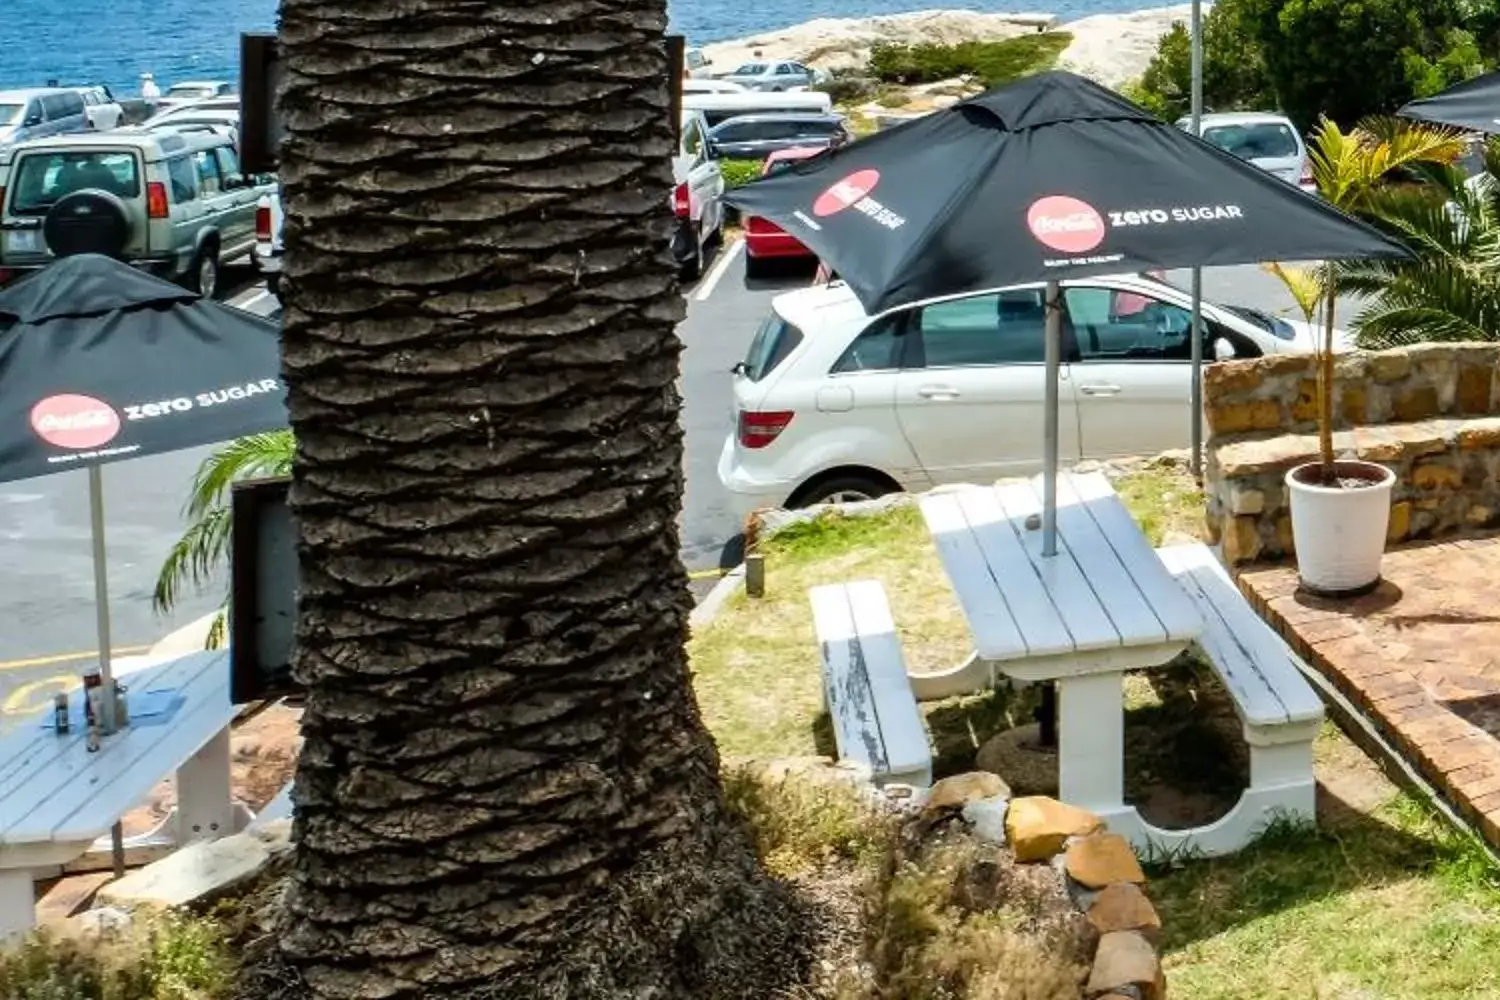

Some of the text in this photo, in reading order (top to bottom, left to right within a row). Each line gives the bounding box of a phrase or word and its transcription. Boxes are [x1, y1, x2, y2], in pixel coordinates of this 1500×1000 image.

[1108, 209, 1169, 227] zero
[1171, 205, 1243, 222] SUGAR
[123, 396, 193, 421] zero
[195, 378, 279, 407] SUGAR
